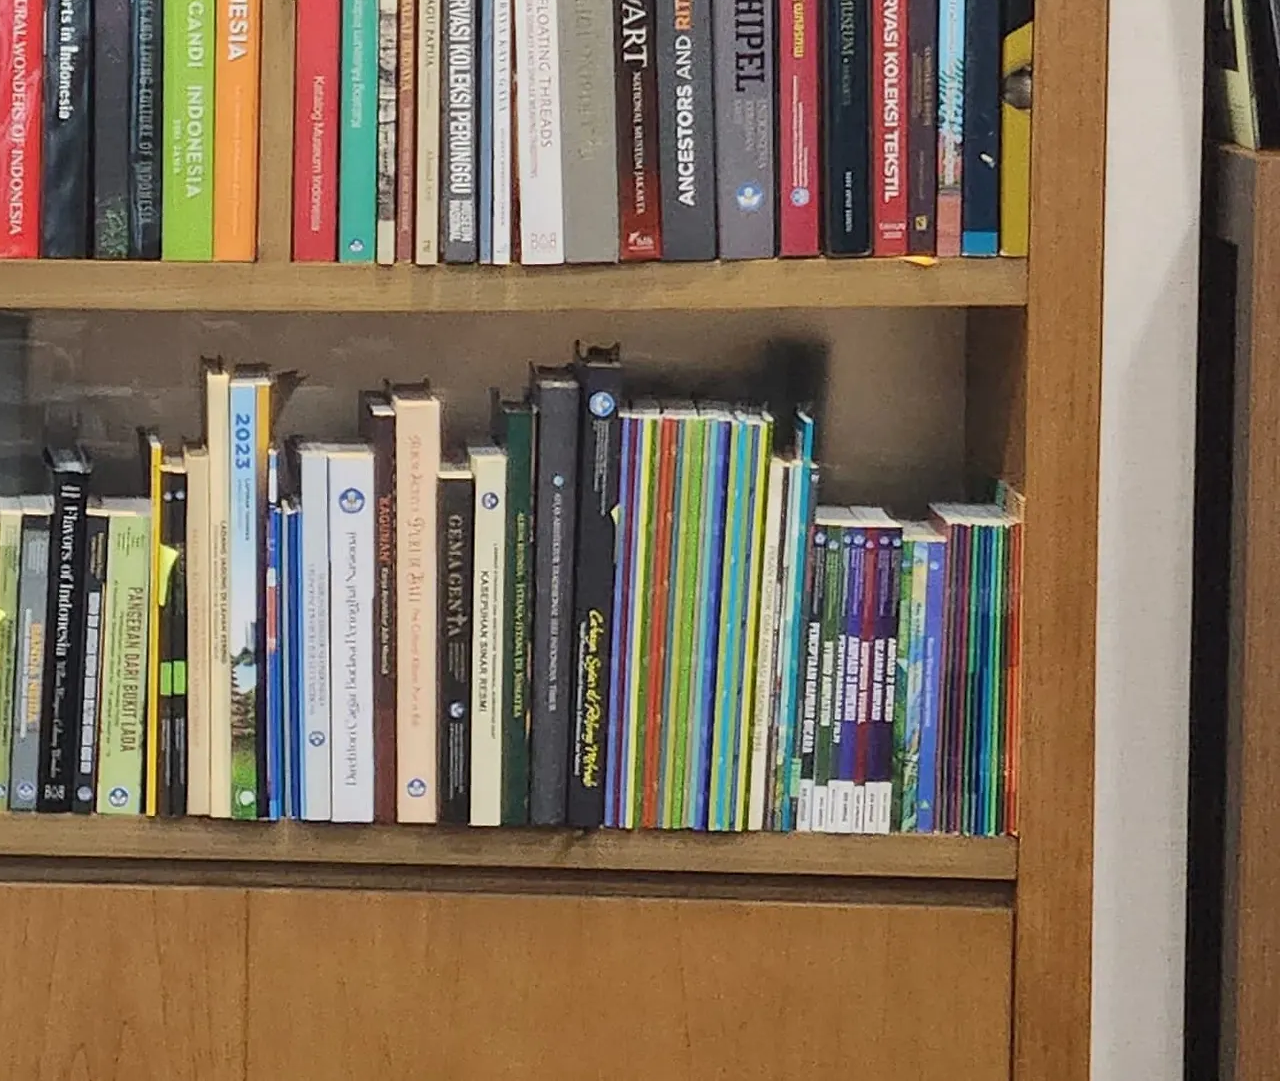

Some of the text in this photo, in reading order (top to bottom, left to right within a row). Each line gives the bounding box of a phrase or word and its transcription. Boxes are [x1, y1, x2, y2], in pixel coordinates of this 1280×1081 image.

[59, 26, 78, 41] in
[425, 28, 435, 67] PAPUA
[621, 1, 648, 68] ART
[674, 35, 695, 81] AND
[792, 3, 806, 58] museum
[12, 41, 28, 120] WONDERS
[58, 44, 80, 120] Indonesia
[184, 0, 204, 199] CANDI INDONESIA
[449, 43, 471, 109] KOLEKSI
[883, 52, 899, 128] KOLEKSI
[12, 123, 27, 146] OF
[539, 75, 554, 149] THREADS
[139, 141, 153, 158] OF
[309, 75, 324, 232] Katalog Museum Indonesia
[449, 111, 472, 194] PERUNGGU
[674, 86, 697, 208] ANCESTORS
[883, 130, 899, 203] TEKSTIL
[8, 149, 26, 235] INDONESIA
[138, 160, 154, 225] INDONESIA
[234, 413, 252, 471] 2023
[54, 505, 79, 656] Flavors of Indonesia
[446, 514, 470, 637] GEMA GENTA
[28, 622, 42, 676] BANDA
[122, 652, 139, 682] DARI
[478, 570, 490, 712] KASEPUHAN SINAR RESMI
[121, 684, 139, 718] BUKIT
[119, 720, 138, 753] LADA
